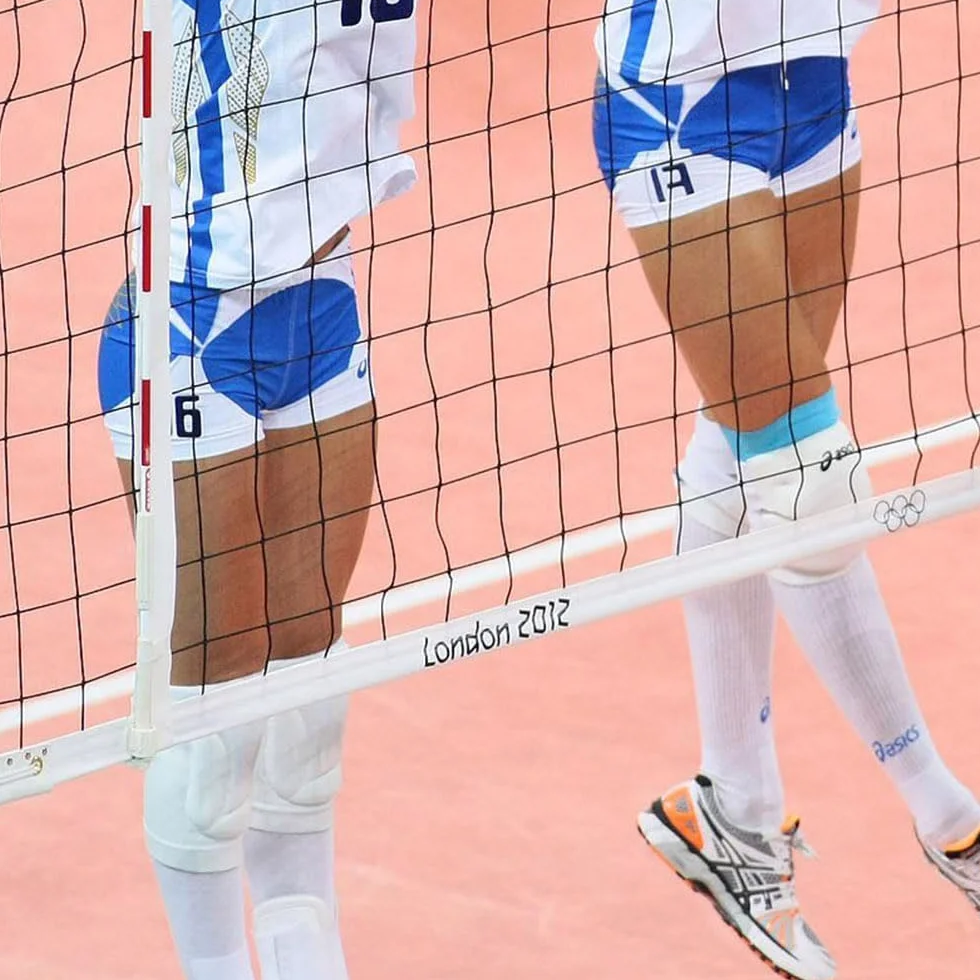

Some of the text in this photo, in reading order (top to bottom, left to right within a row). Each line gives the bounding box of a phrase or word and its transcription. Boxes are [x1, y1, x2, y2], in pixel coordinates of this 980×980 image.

[171, 395, 202, 438] 6
[423, 598, 570, 667] London 2012
